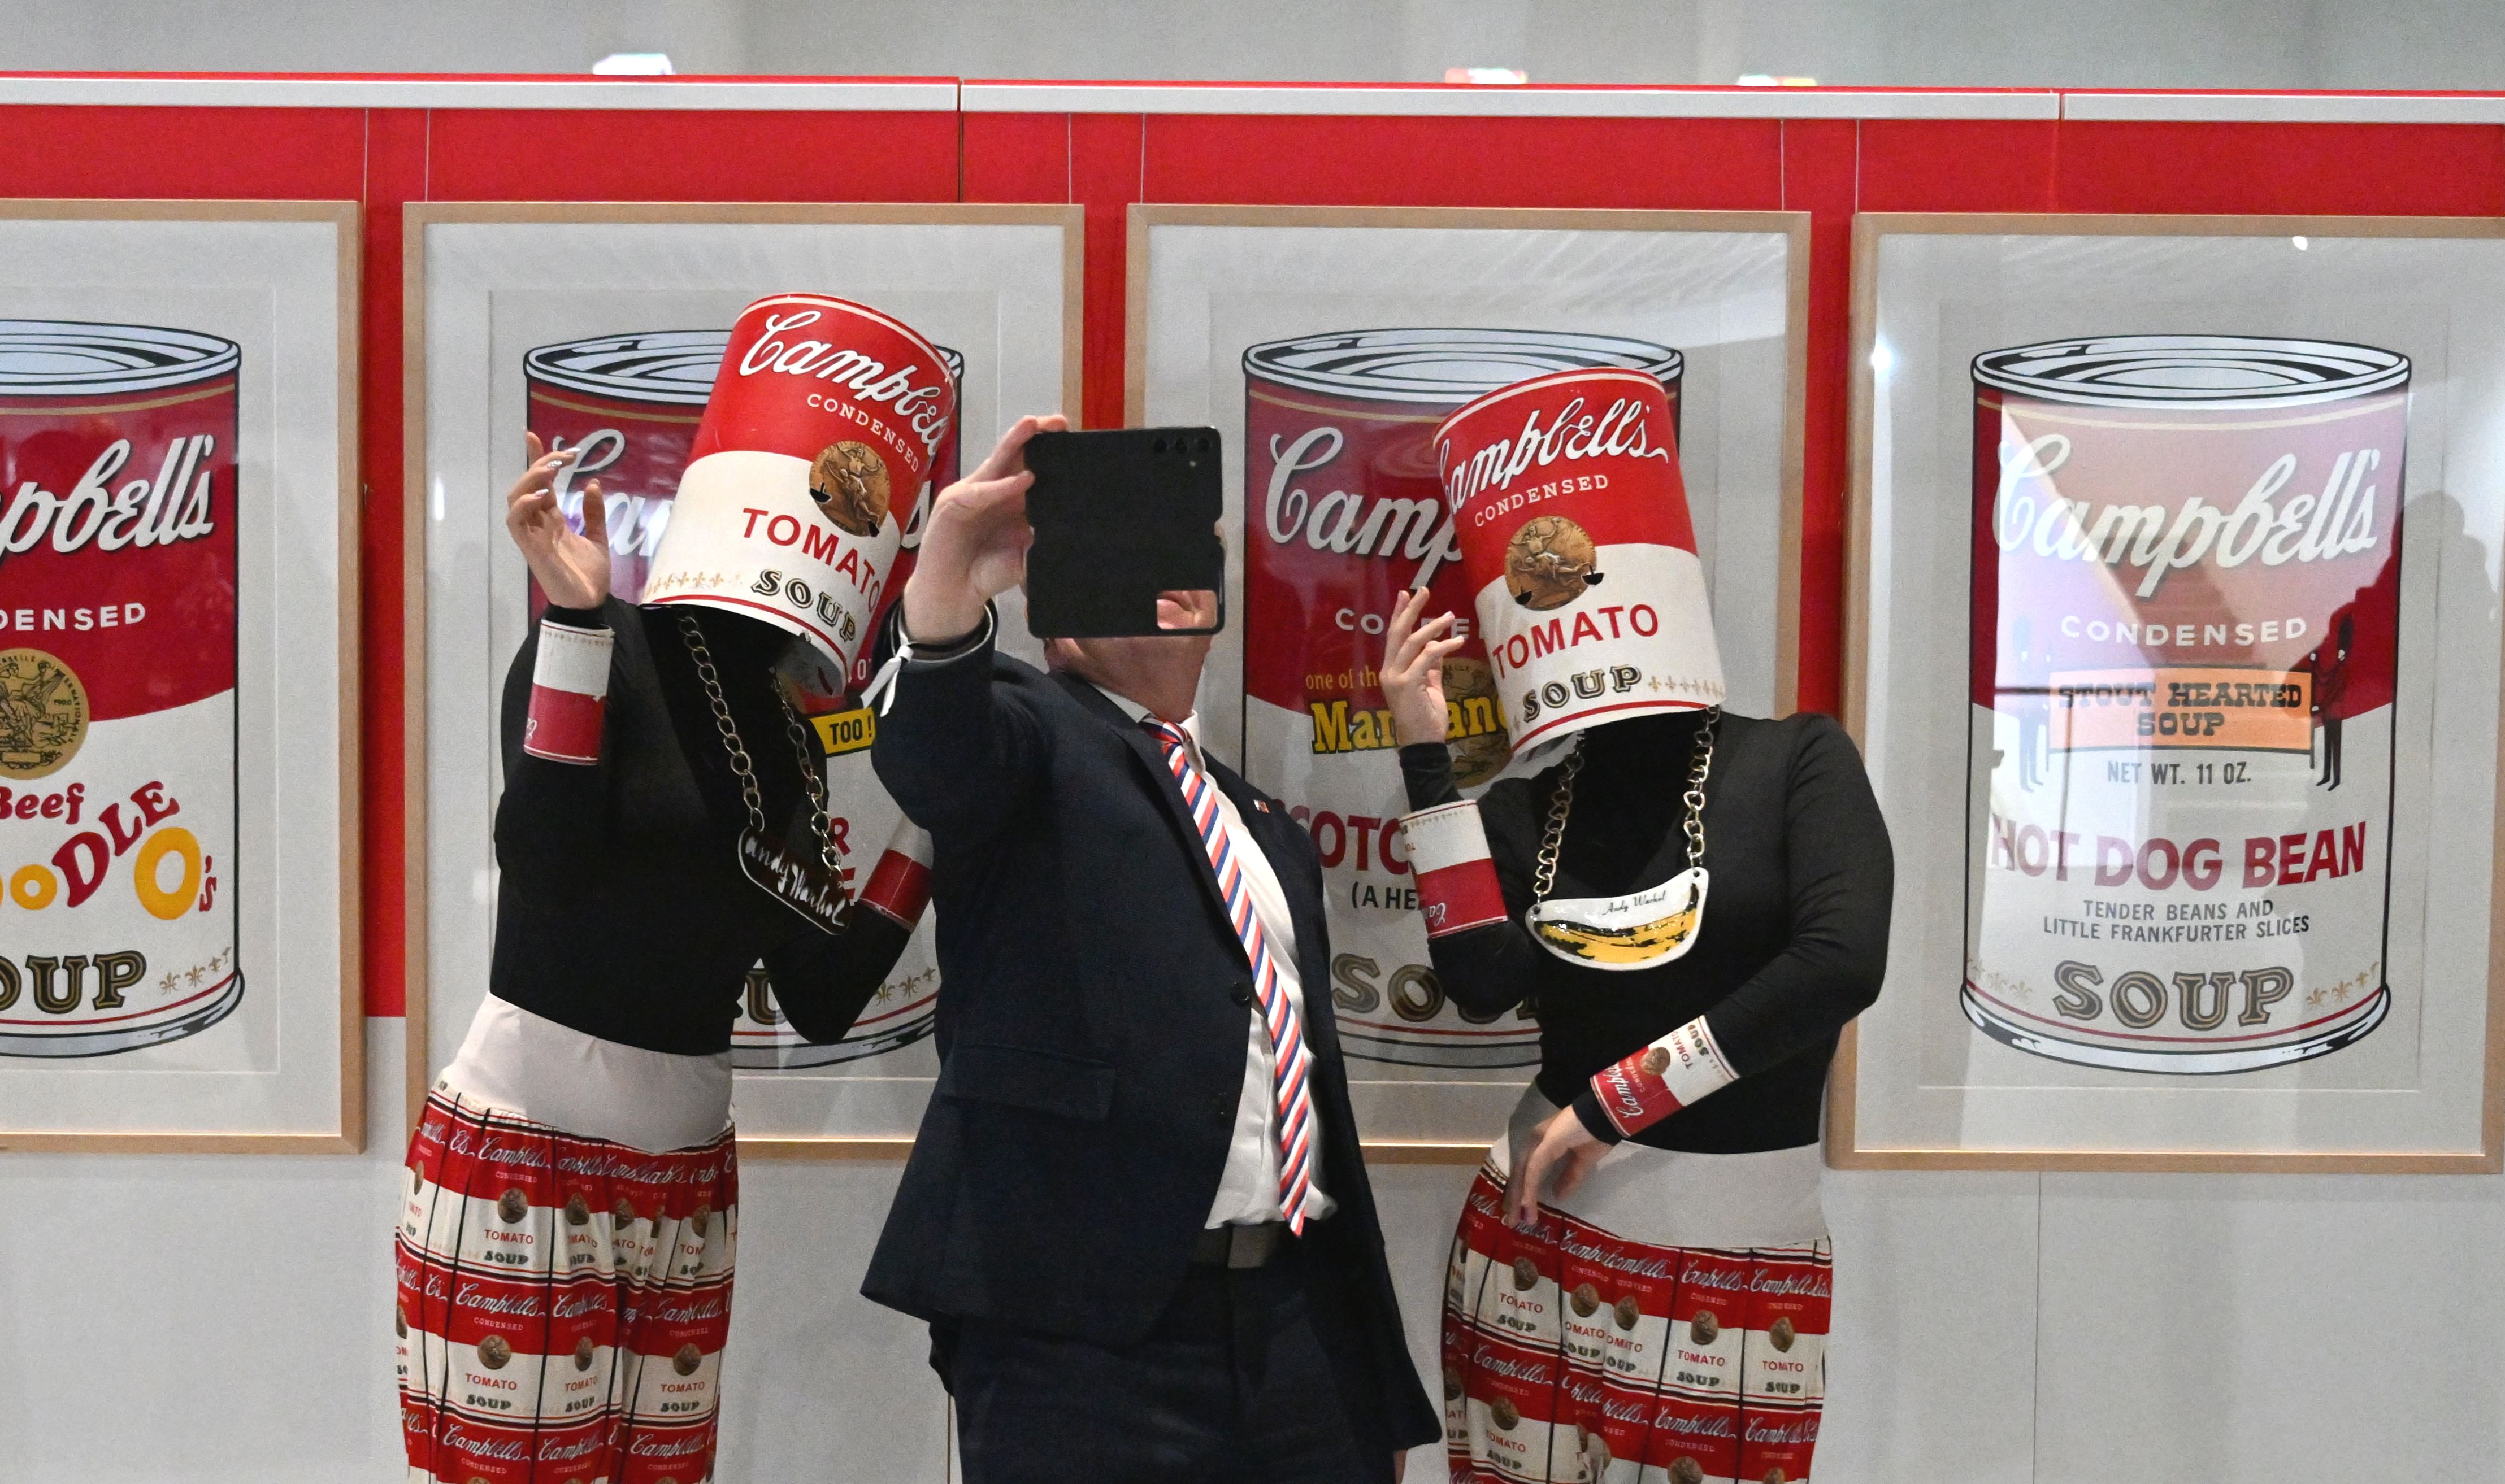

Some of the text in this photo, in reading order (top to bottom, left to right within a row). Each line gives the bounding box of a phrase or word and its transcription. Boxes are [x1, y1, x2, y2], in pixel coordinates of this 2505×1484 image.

[807, 393, 919, 473] CONDENSED
[0, 434, 214, 564] pbell's
[1475, 475, 1608, 527] CONDENSED
[1992, 433, 2381, 597] Campbell's
[743, 508, 880, 614] TOMATO
[751, 568, 856, 642] SOUP
[1492, 604, 1659, 679] TOMATO
[2061, 616, 2306, 647] CONDENSED
[1306, 665, 1379, 690] one of th
[1523, 664, 1642, 722] SOUP
[2059, 683, 2302, 708] STOUT HEARTED
[2136, 713, 2225, 736] SOUP
[2107, 761, 2252, 785] NET WT. 11 OZ.
[1991, 814, 2367, 891] HOT DOG BEAN
[1601, 900, 1629, 916] Andy
[2083, 899, 2274, 921] TENDER BEANS AND
[2043, 915, 2310, 943] LITTLE FRANKFURTER SLICES
[2052, 959, 2294, 1032] SOUP
[1670, 1031, 1693, 1069] TOMATO
[484, 1229, 534, 1244] TOMATO
[484, 1250, 529, 1265] SOUP
[474, 1317, 524, 1331] CONDENSED
[1497, 1314, 1536, 1332] SOUP
[1564, 1321, 1605, 1339] OMATO
[1567, 1342, 1601, 1358] OUP
[1677, 1349, 1726, 1367] TOMATO
[1606, 1356, 1636, 1373] OUP
[465, 1373, 518, 1391] TOMATO
[565, 1376, 598, 1392] TOMATO
[661, 1381, 705, 1393] TOMATO
[1675, 1370, 1720, 1387] SOUP
[466, 1394, 512, 1411] SOUP
[565, 1396, 595, 1413] SOUP
[660, 1400, 700, 1412] SOUP
[1486, 1429, 1526, 1453] TOMATO
